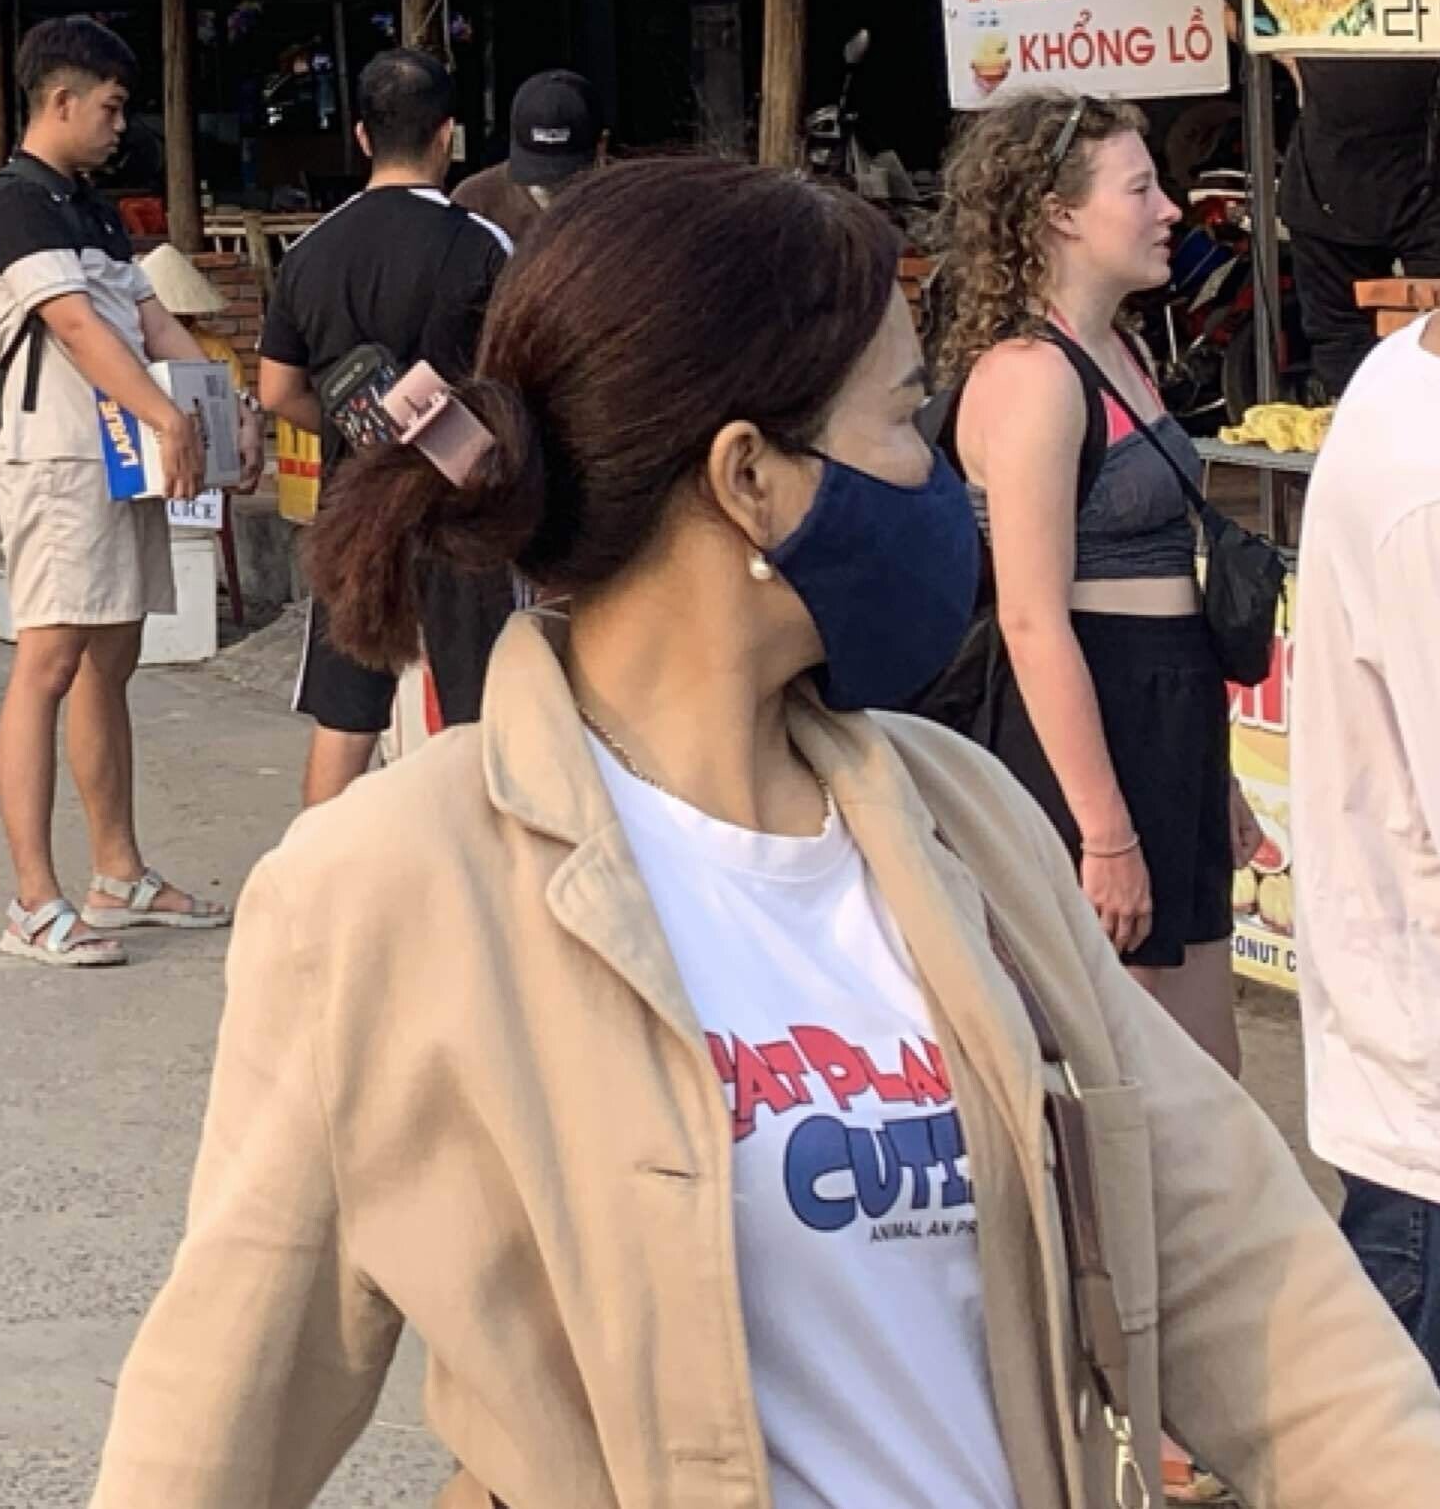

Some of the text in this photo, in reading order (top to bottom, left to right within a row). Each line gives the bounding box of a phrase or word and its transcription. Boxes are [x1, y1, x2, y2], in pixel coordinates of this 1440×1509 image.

[1019, 9, 1155, 72] KHỔNG
[170, 501, 217, 519] UICE
[1235, 935, 1279, 967] ONUT
[783, 1106, 975, 1234] CUTI
